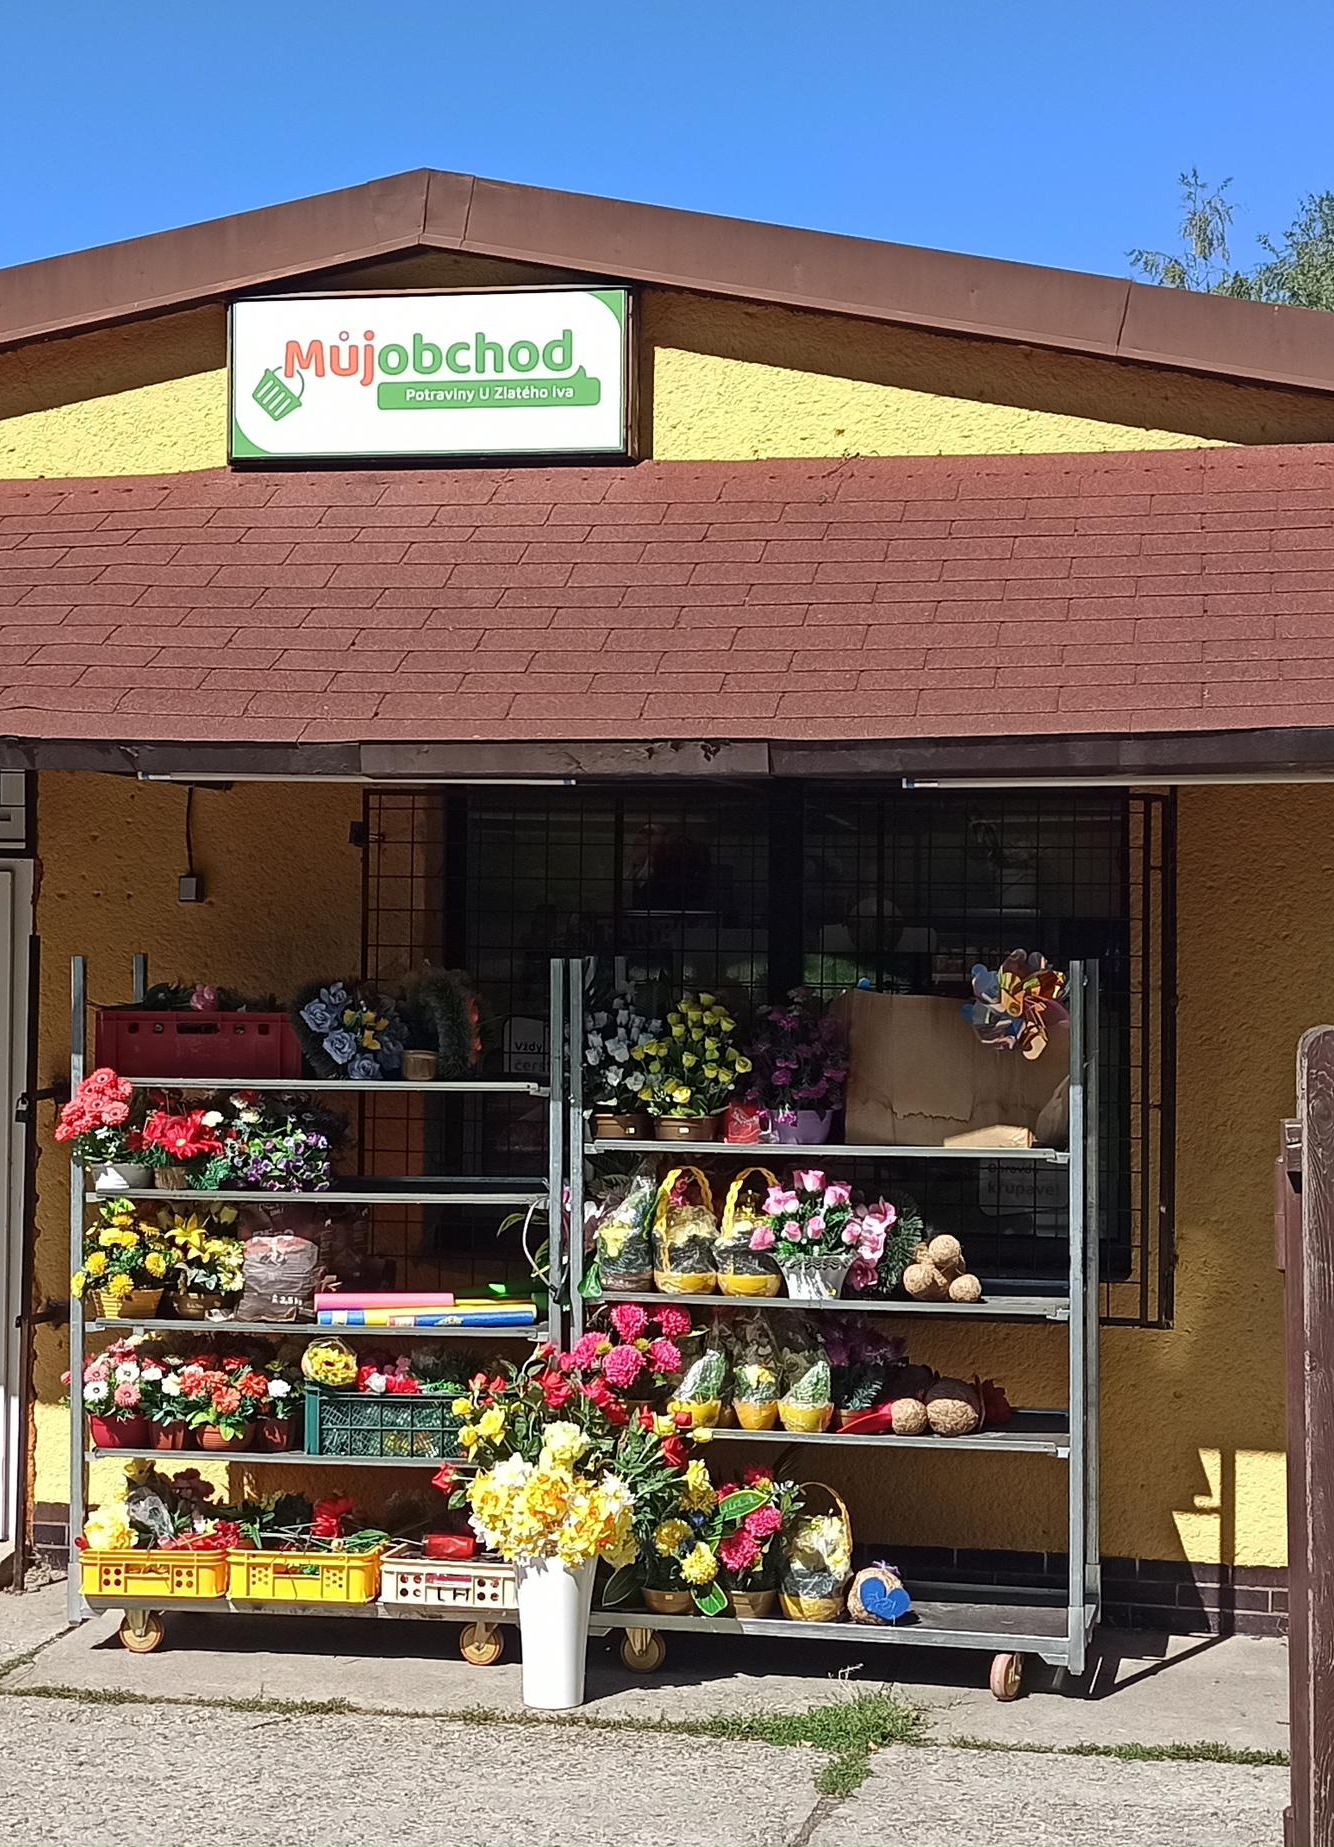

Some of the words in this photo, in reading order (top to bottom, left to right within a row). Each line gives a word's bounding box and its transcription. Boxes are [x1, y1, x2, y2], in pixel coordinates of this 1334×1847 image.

[405, 387, 475, 403] Potraviny
[478, 387, 490, 400] U
[494, 385, 549, 399] Zlatého
